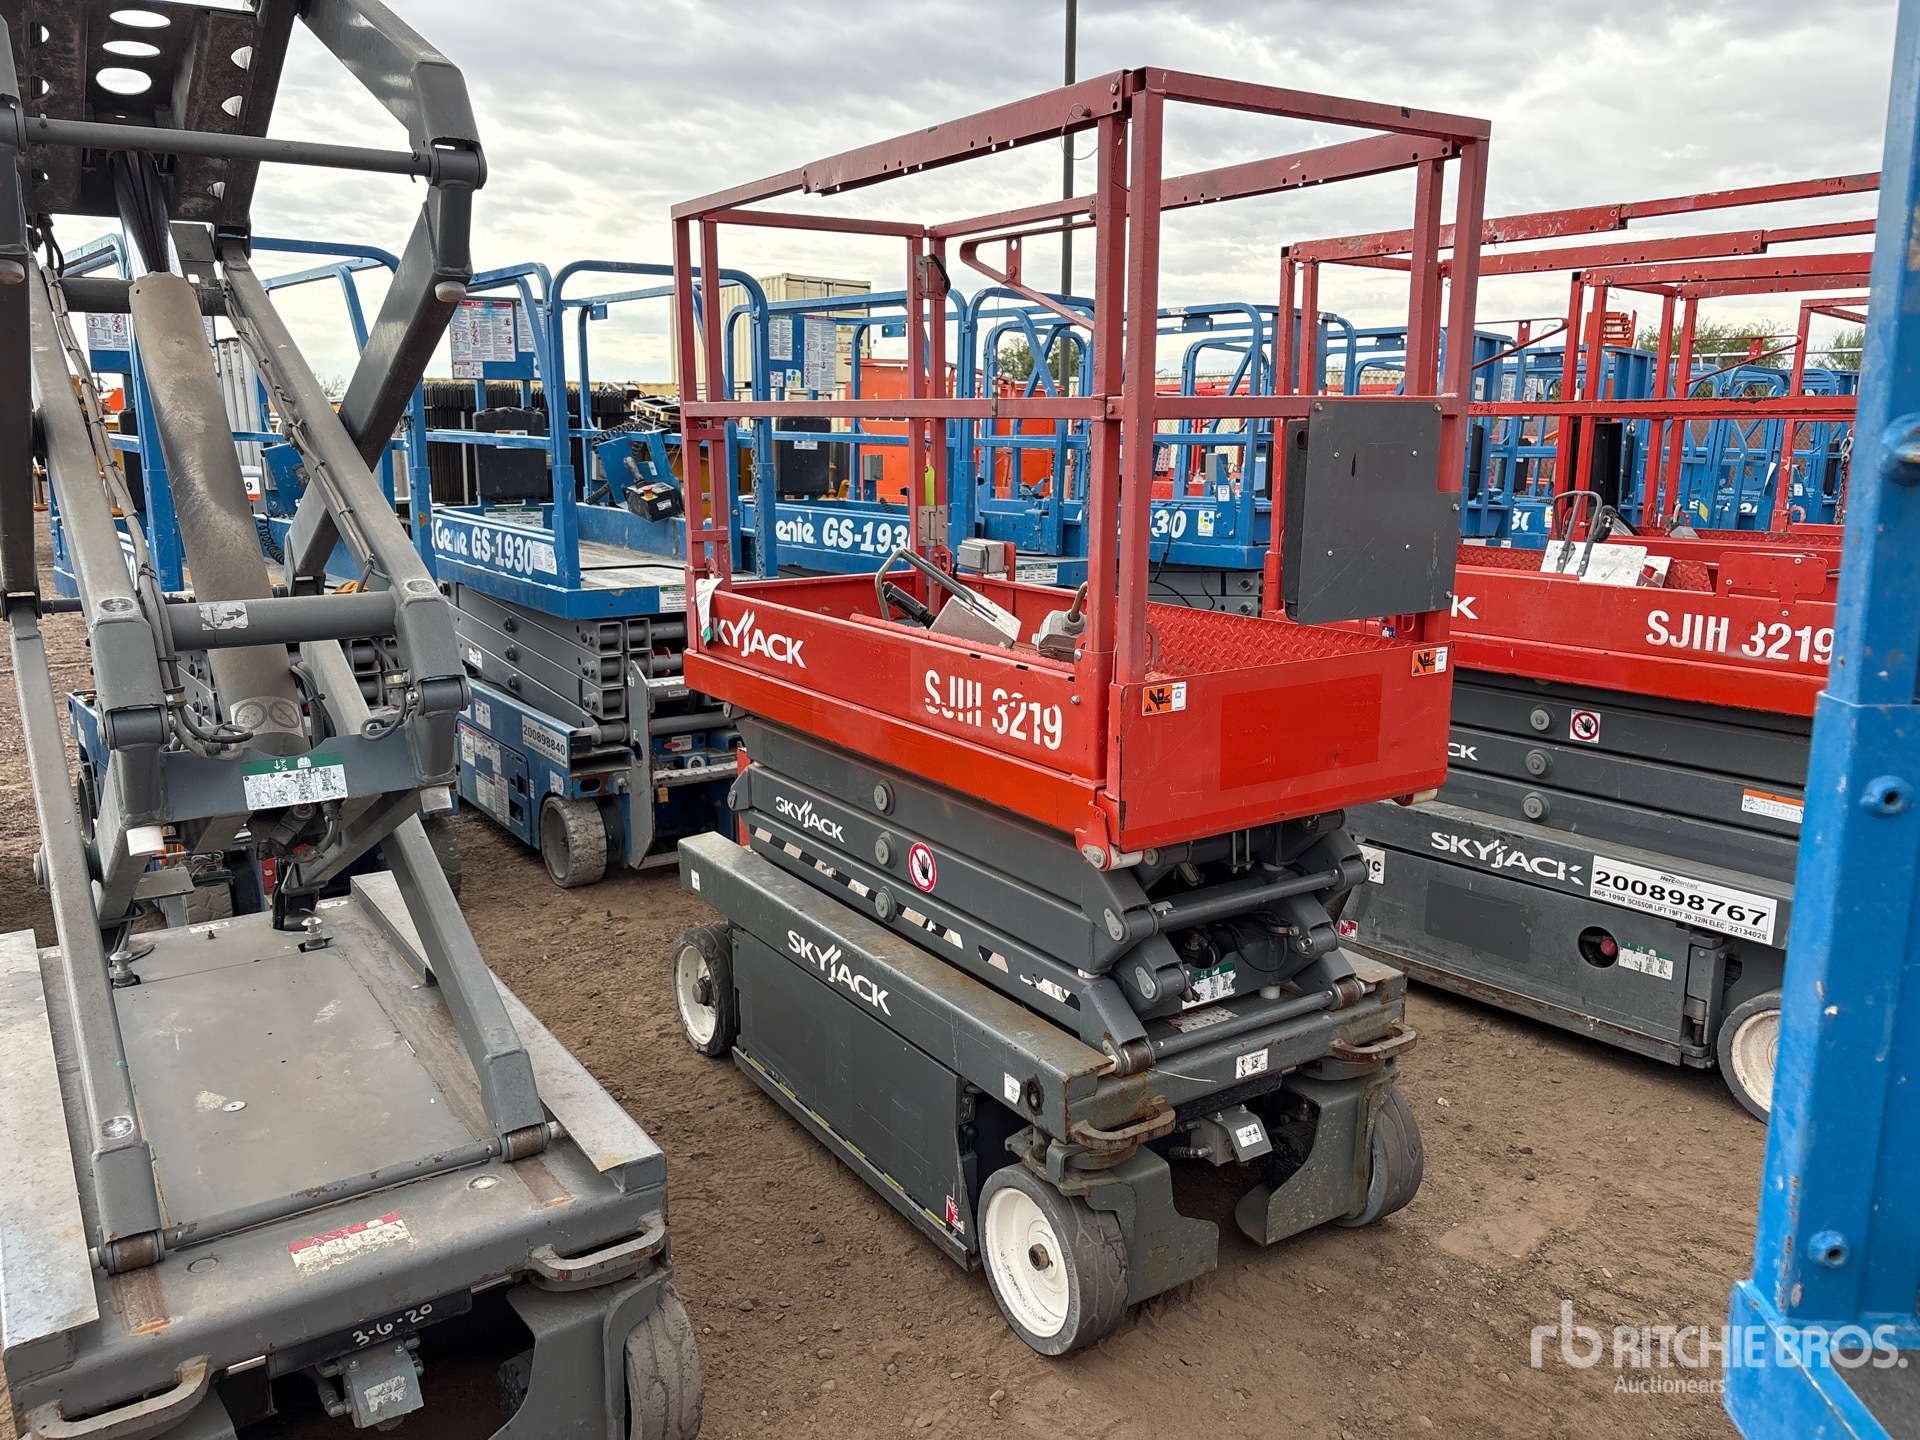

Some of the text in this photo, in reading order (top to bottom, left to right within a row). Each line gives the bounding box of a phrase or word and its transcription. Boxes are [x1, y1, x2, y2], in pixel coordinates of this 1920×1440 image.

[435, 518, 534, 576] Genie GS-1930
[775, 515, 910, 554] enie GS-193
[709, 608, 807, 669] KYJACK
[1741, 621, 1835, 665] 3219
[523, 724, 566, 756] 200898840
[991, 687, 1063, 750] 3219
[775, 795, 845, 843] SKYJACK
[1431, 831, 1585, 886] SKYJACK
[1592, 889, 1768, 941] 405-1090 SCISSOR LIFT 19FT 30-32IN ELEC 22134025
[1594, 870, 1768, 926] 200898767
[787, 929, 892, 1017] SKYJACK
